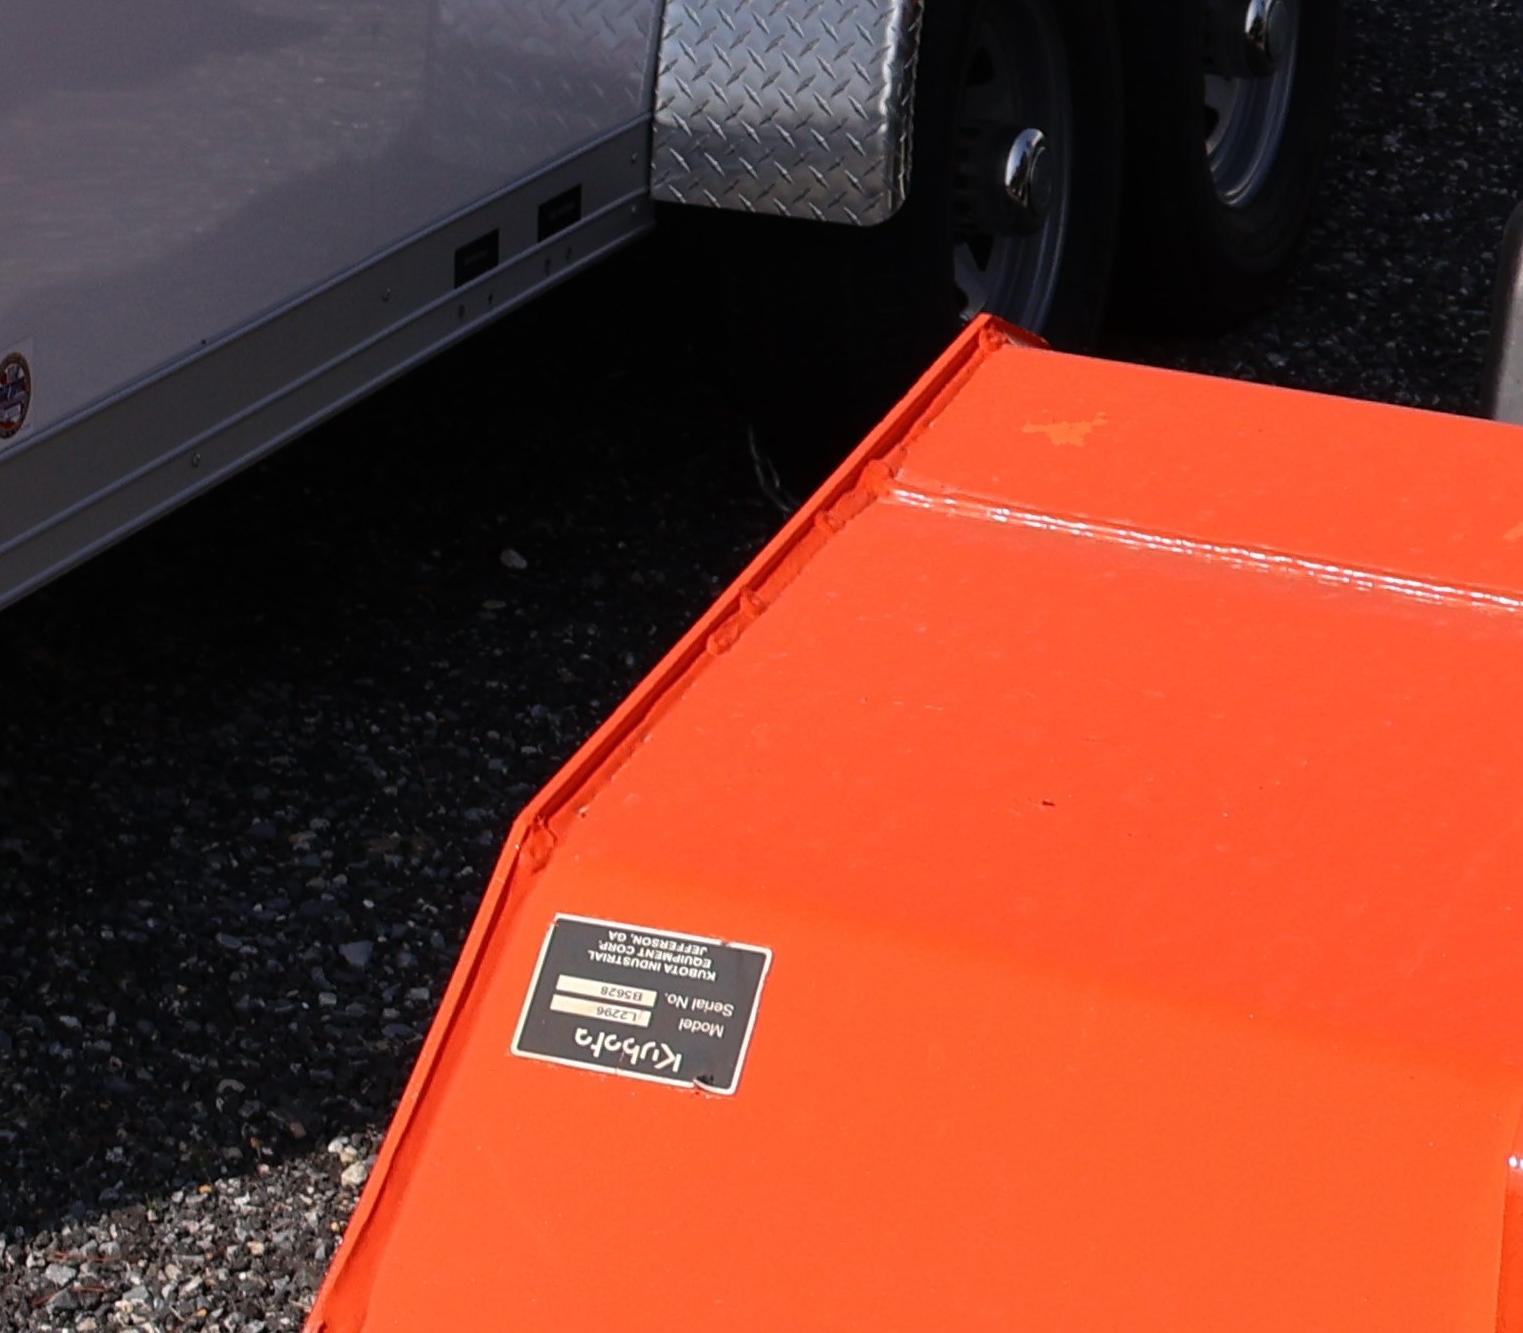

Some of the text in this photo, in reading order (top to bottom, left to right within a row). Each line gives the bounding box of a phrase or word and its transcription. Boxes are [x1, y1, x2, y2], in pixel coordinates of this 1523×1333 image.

[608, 930, 708, 956] JEFFERSON, GA
[587, 949, 717, 981] KUBOTA INDUSTRIAL
[636, 946, 712, 968] EQUIPMENT
[664, 991, 688, 1009] No.
[692, 998, 735, 1017] Serial
[596, 1006, 725, 1038] Model L2296
[574, 1027, 682, 1072] Kubota
